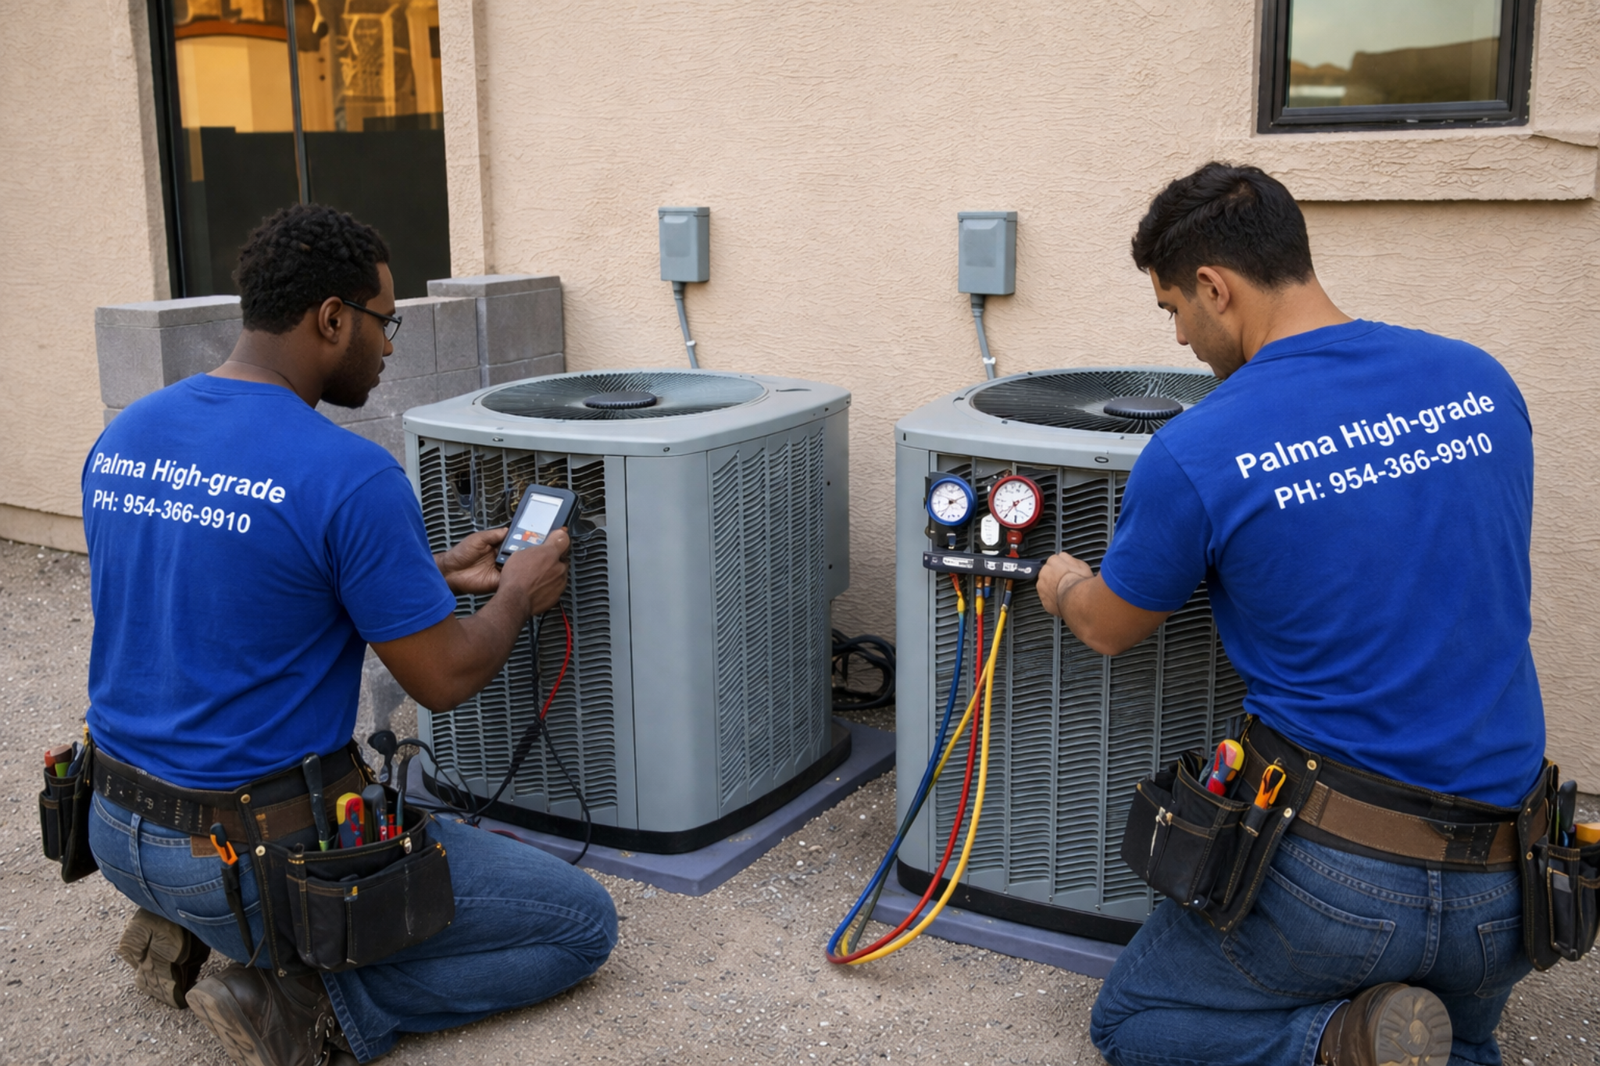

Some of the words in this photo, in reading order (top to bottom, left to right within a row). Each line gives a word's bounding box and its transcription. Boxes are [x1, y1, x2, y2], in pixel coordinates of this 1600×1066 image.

[1235, 435, 1339, 479] Palma
[1339, 391, 1495, 448] High-grade
[91, 452, 147, 479] Palma
[151, 458, 287, 504] High-grade
[1274, 479, 1326, 510] PH:
[1328, 432, 1493, 494] 954-366-9910
[92, 489, 119, 512] PH:
[122, 493, 251, 534] 954-366-9910
